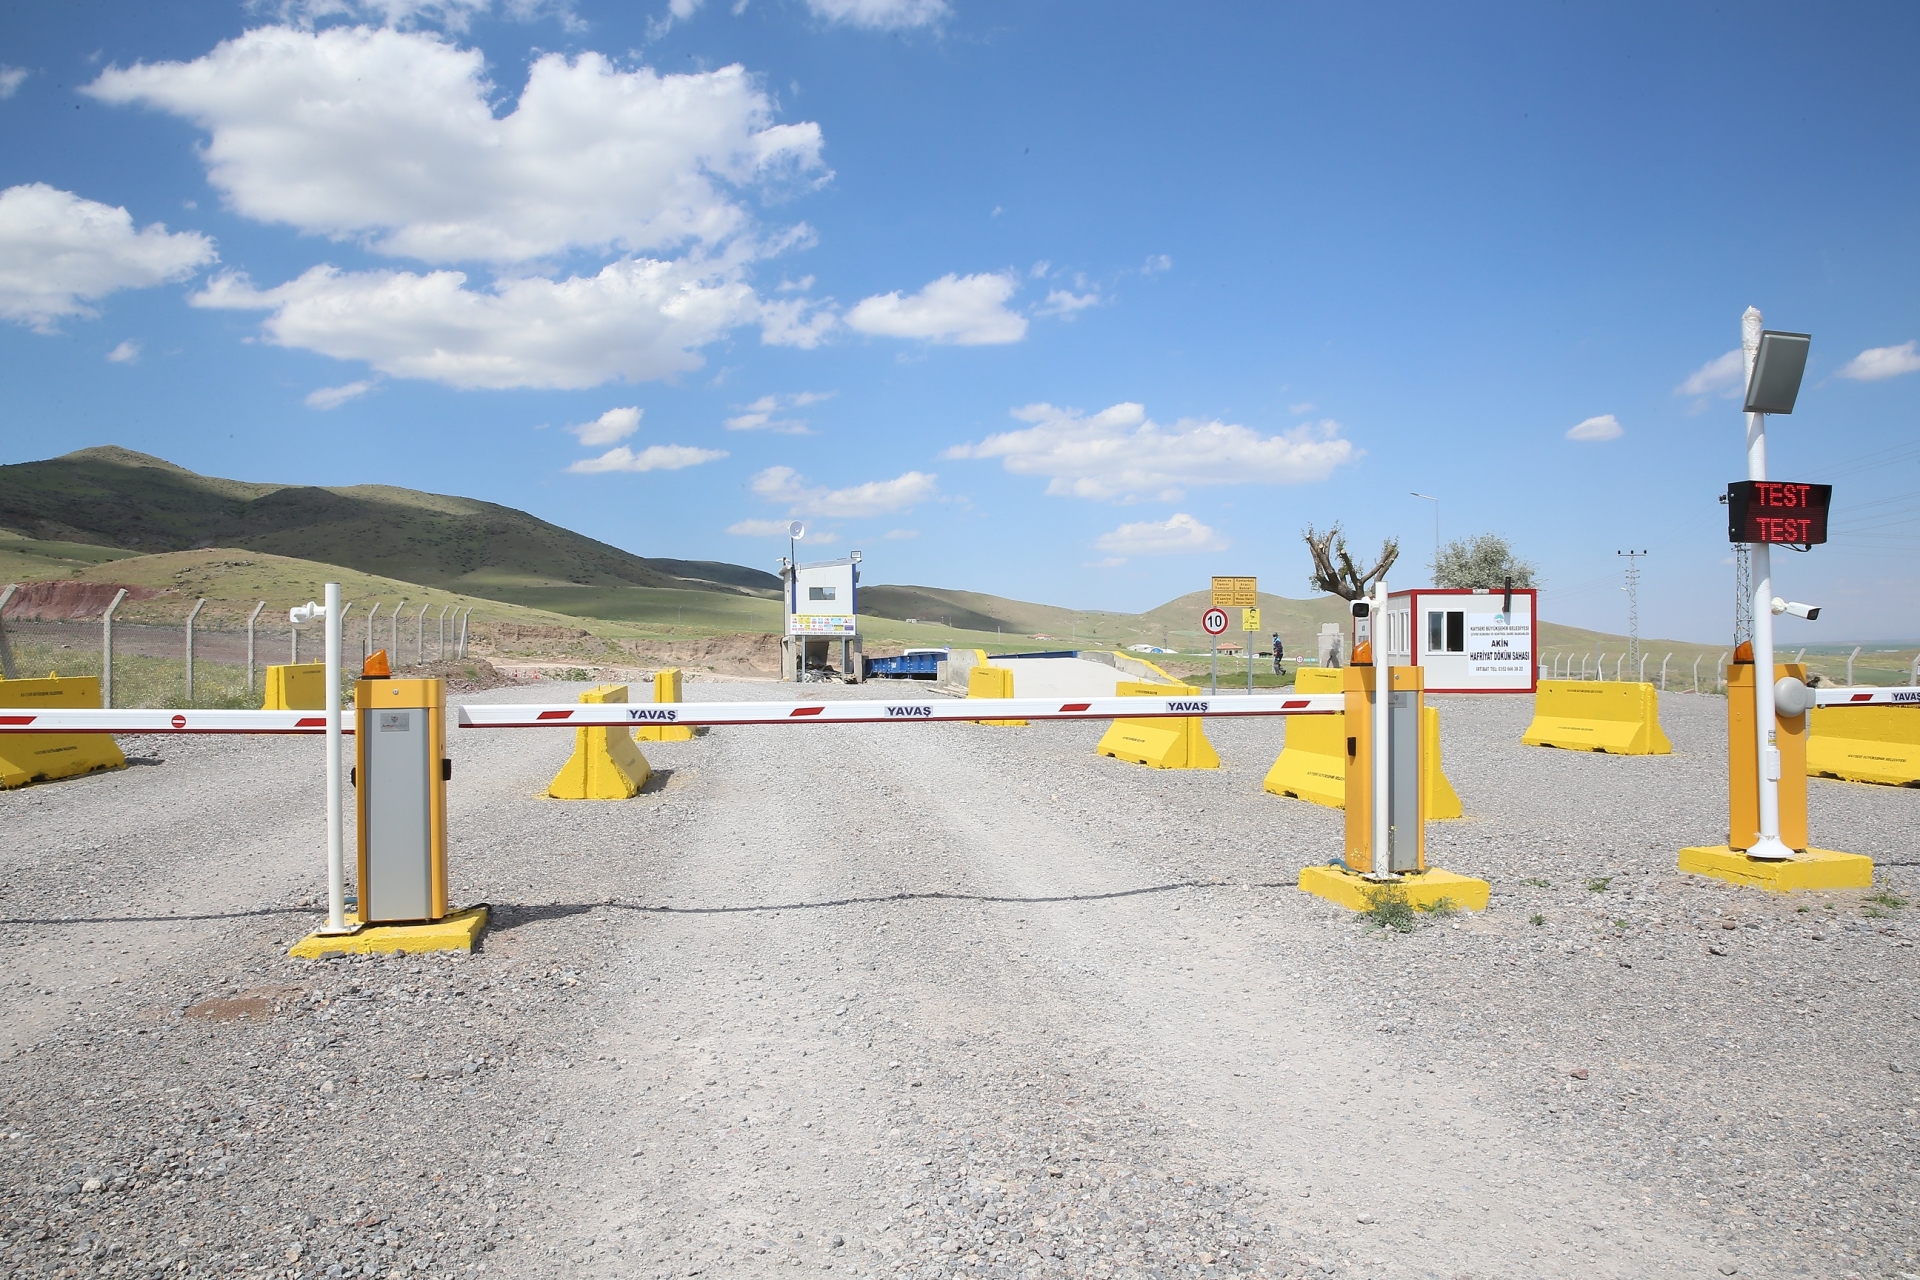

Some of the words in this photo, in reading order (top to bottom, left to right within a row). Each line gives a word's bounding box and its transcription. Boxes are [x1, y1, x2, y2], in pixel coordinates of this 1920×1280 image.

[1755, 482, 1810, 507] TEST
[1756, 517, 1811, 541] TEST
[1207, 615, 1222, 628] 10
[1491, 638, 1508, 647] AKİN
[1470, 650, 1493, 661] HAFRİYAT
[1494, 650, 1511, 661] DÖKÜM
[1512, 652, 1529, 661] SAHASI
[887, 706, 932, 717] YAVAŞ
[1168, 702, 1208, 713] YAVAŞ
[629, 710, 676, 721] YAVAŞ
